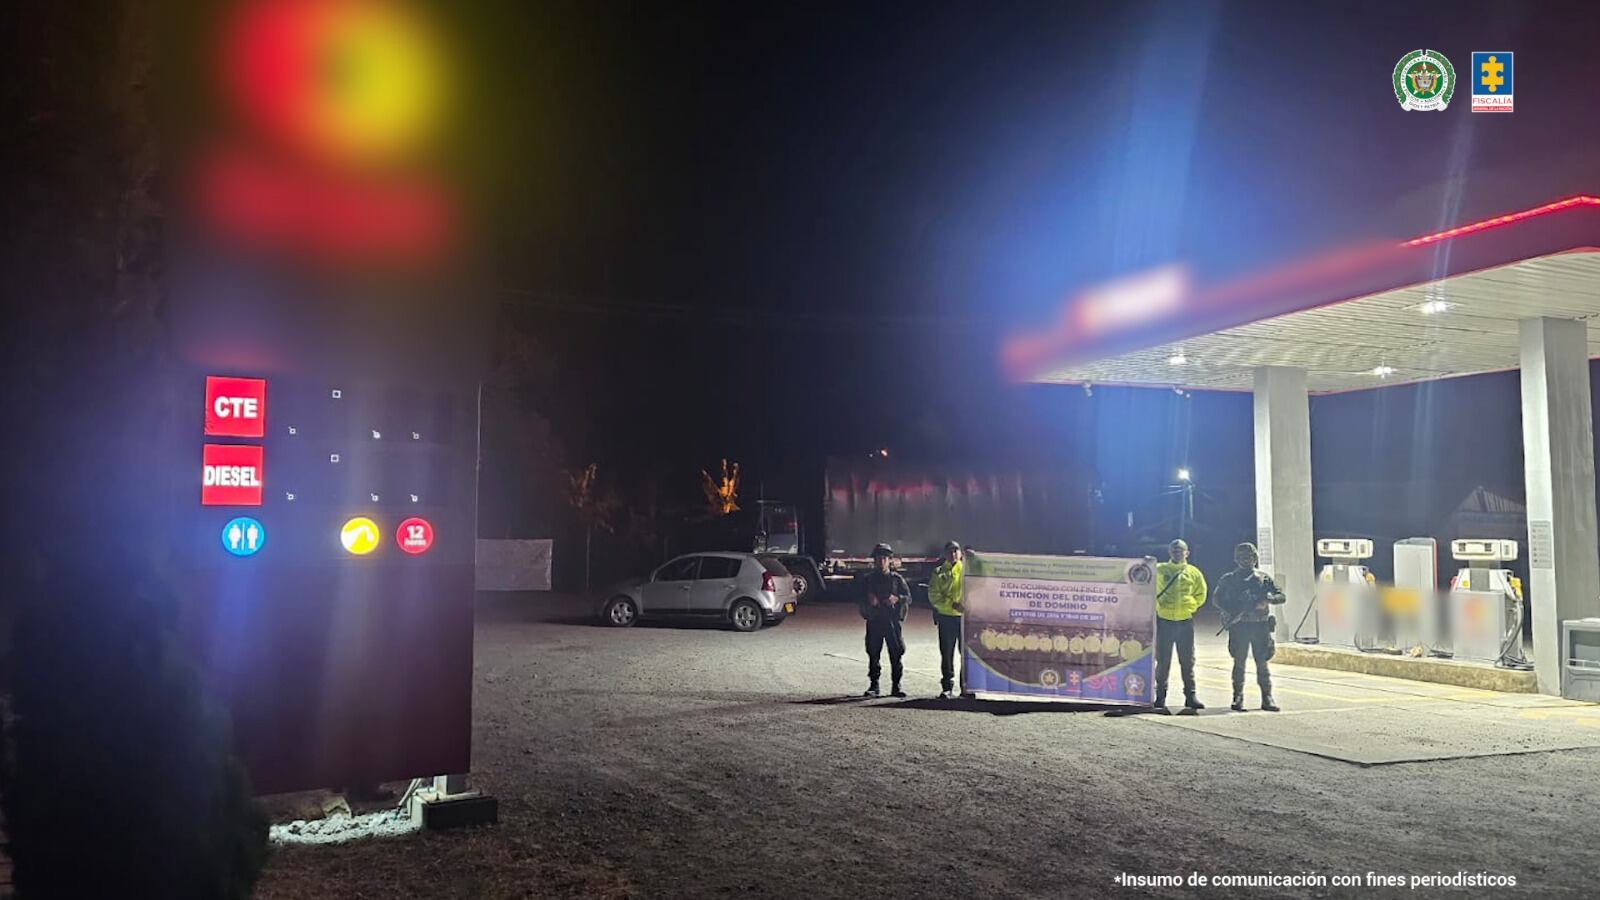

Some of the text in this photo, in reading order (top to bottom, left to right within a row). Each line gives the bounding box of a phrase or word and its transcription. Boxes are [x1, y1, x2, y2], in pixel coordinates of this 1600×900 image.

[214, 396, 258, 419] CTE
[203, 465, 261, 487] DIESEL
[406, 525, 424, 539] 12
[1052, 593, 1071, 601] DEL
[1072, 594, 1119, 604] DERECHO
[1029, 601, 1088, 611] DE DOMINIO
